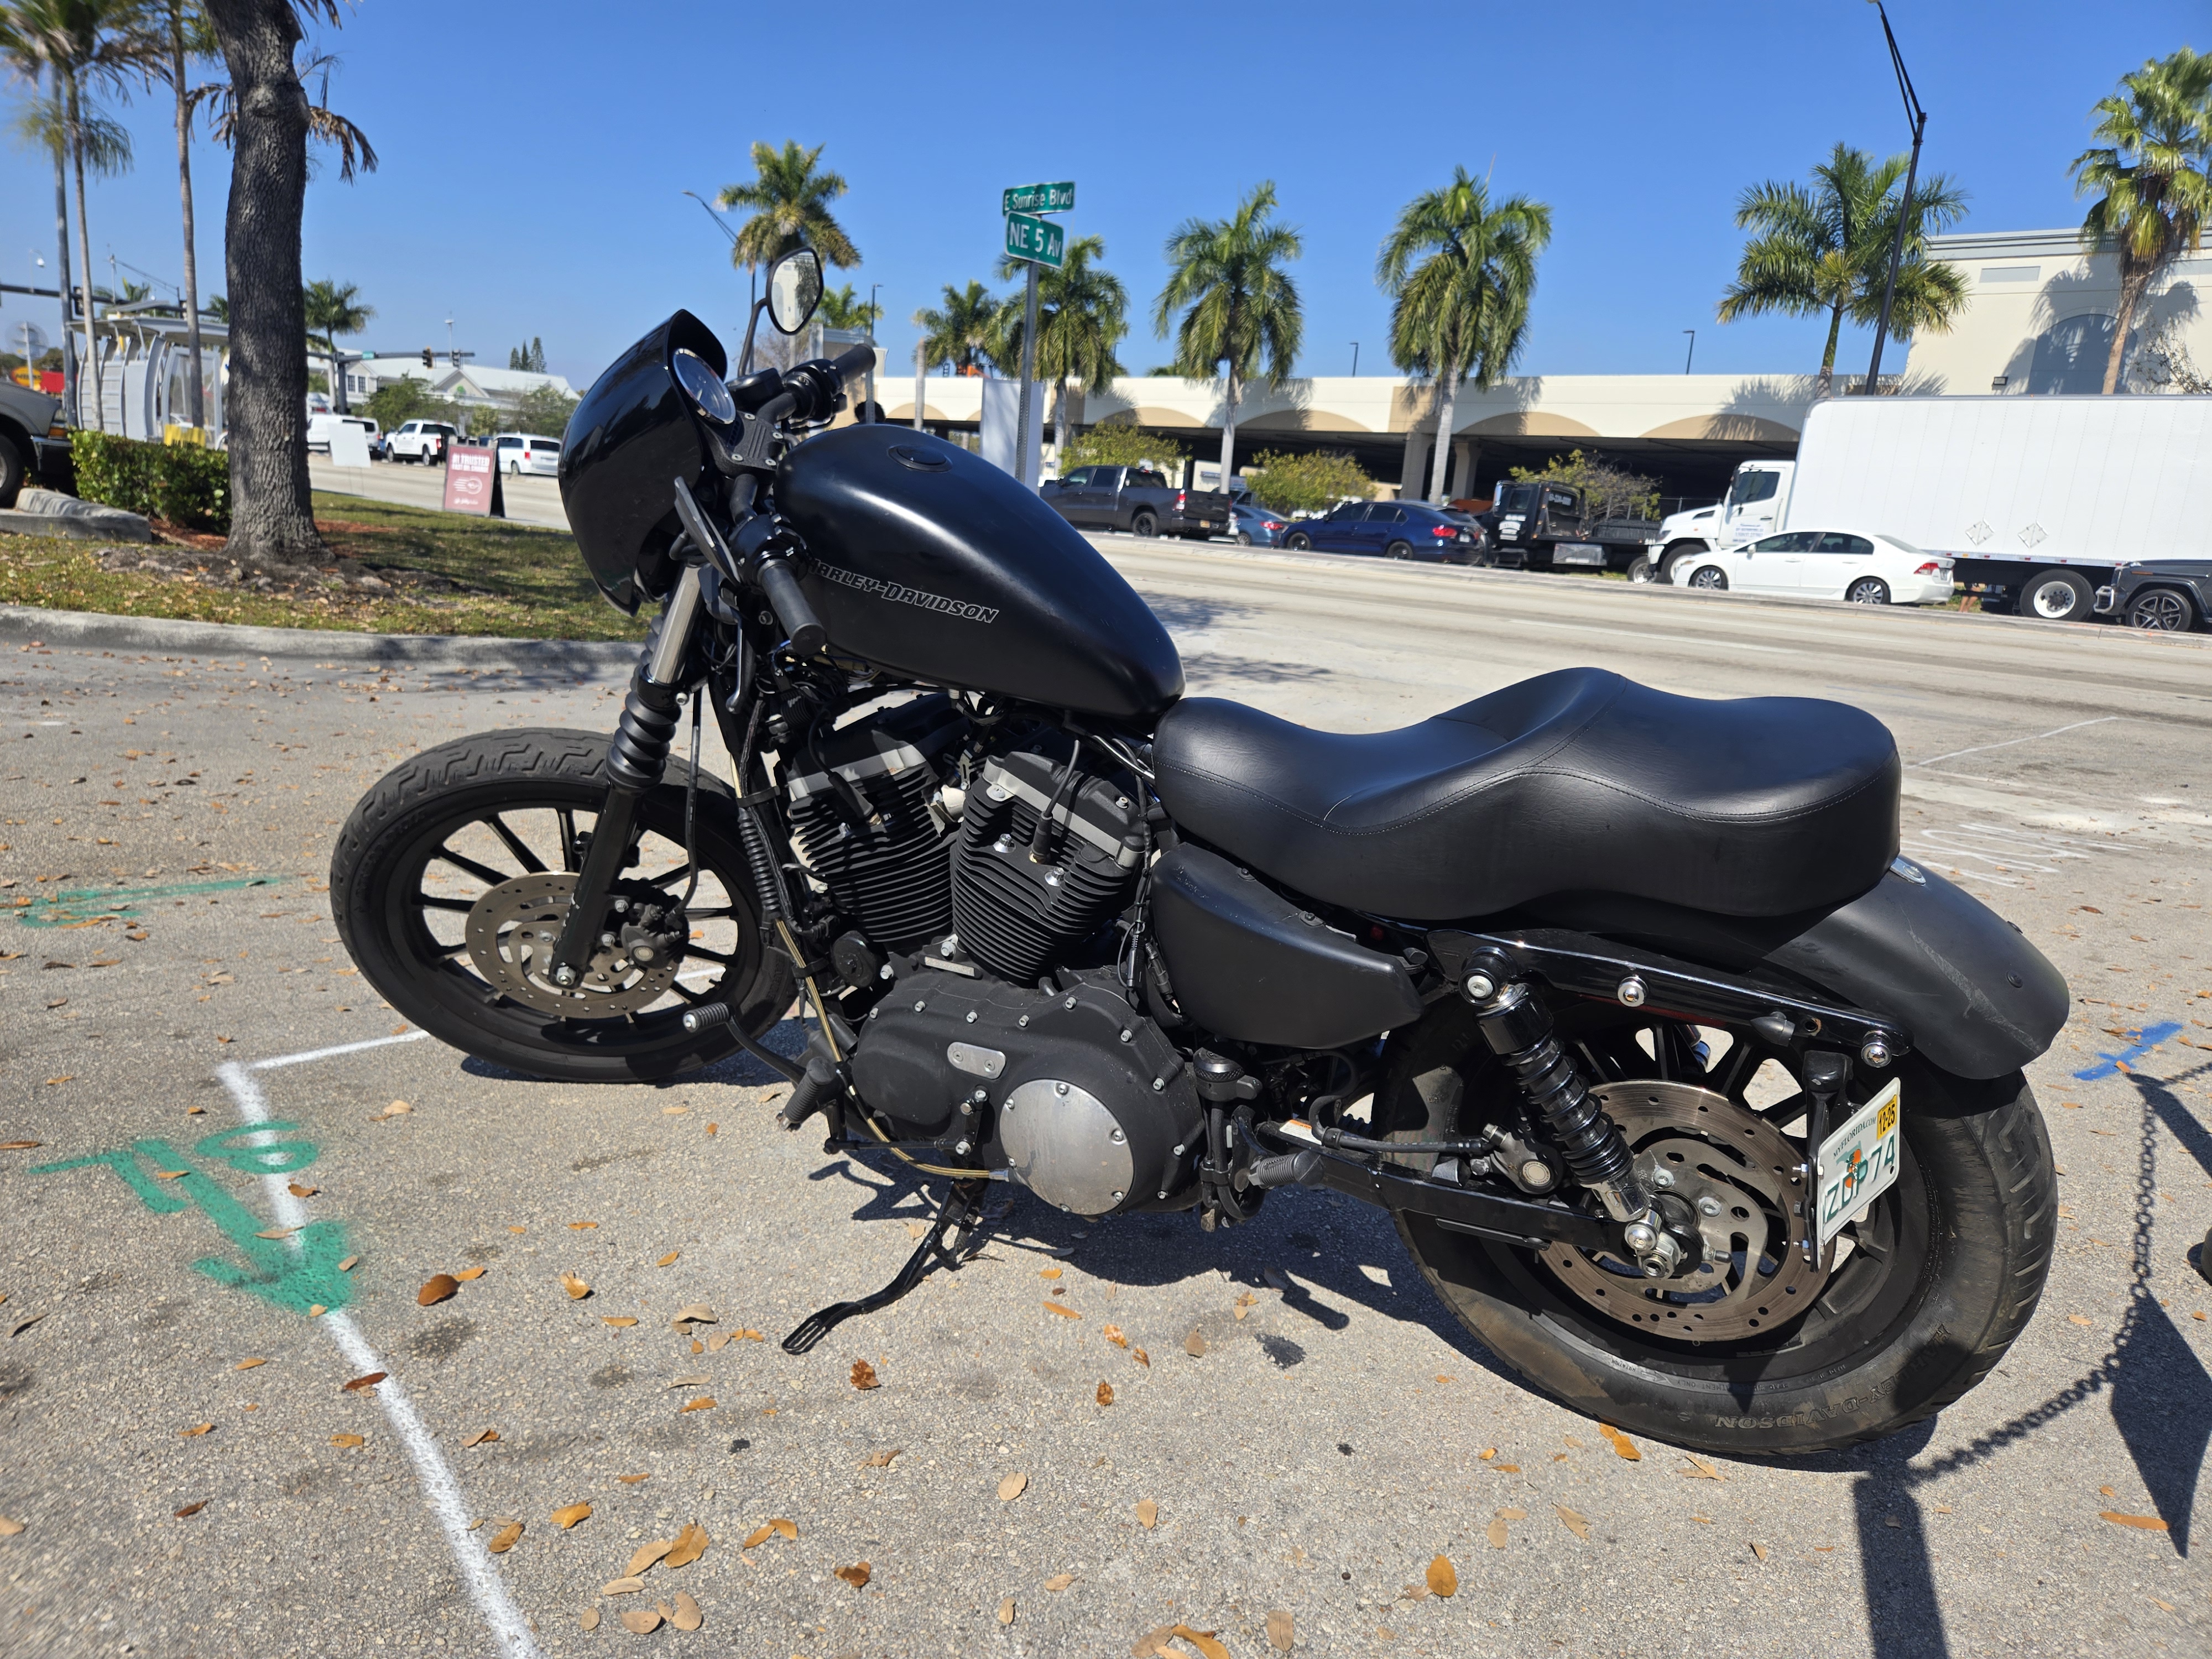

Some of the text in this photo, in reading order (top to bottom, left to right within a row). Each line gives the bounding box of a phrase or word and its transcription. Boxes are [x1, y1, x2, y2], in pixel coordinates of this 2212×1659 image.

[1004, 189, 1072, 211] E Sunrise Blvd
[1009, 222, 1030, 249] NE
[1035, 228, 1044, 253] 5
[808, 558, 999, 623] HARLEY-DAVIDSON
[1823, 1134, 1895, 1224] ZDP74
